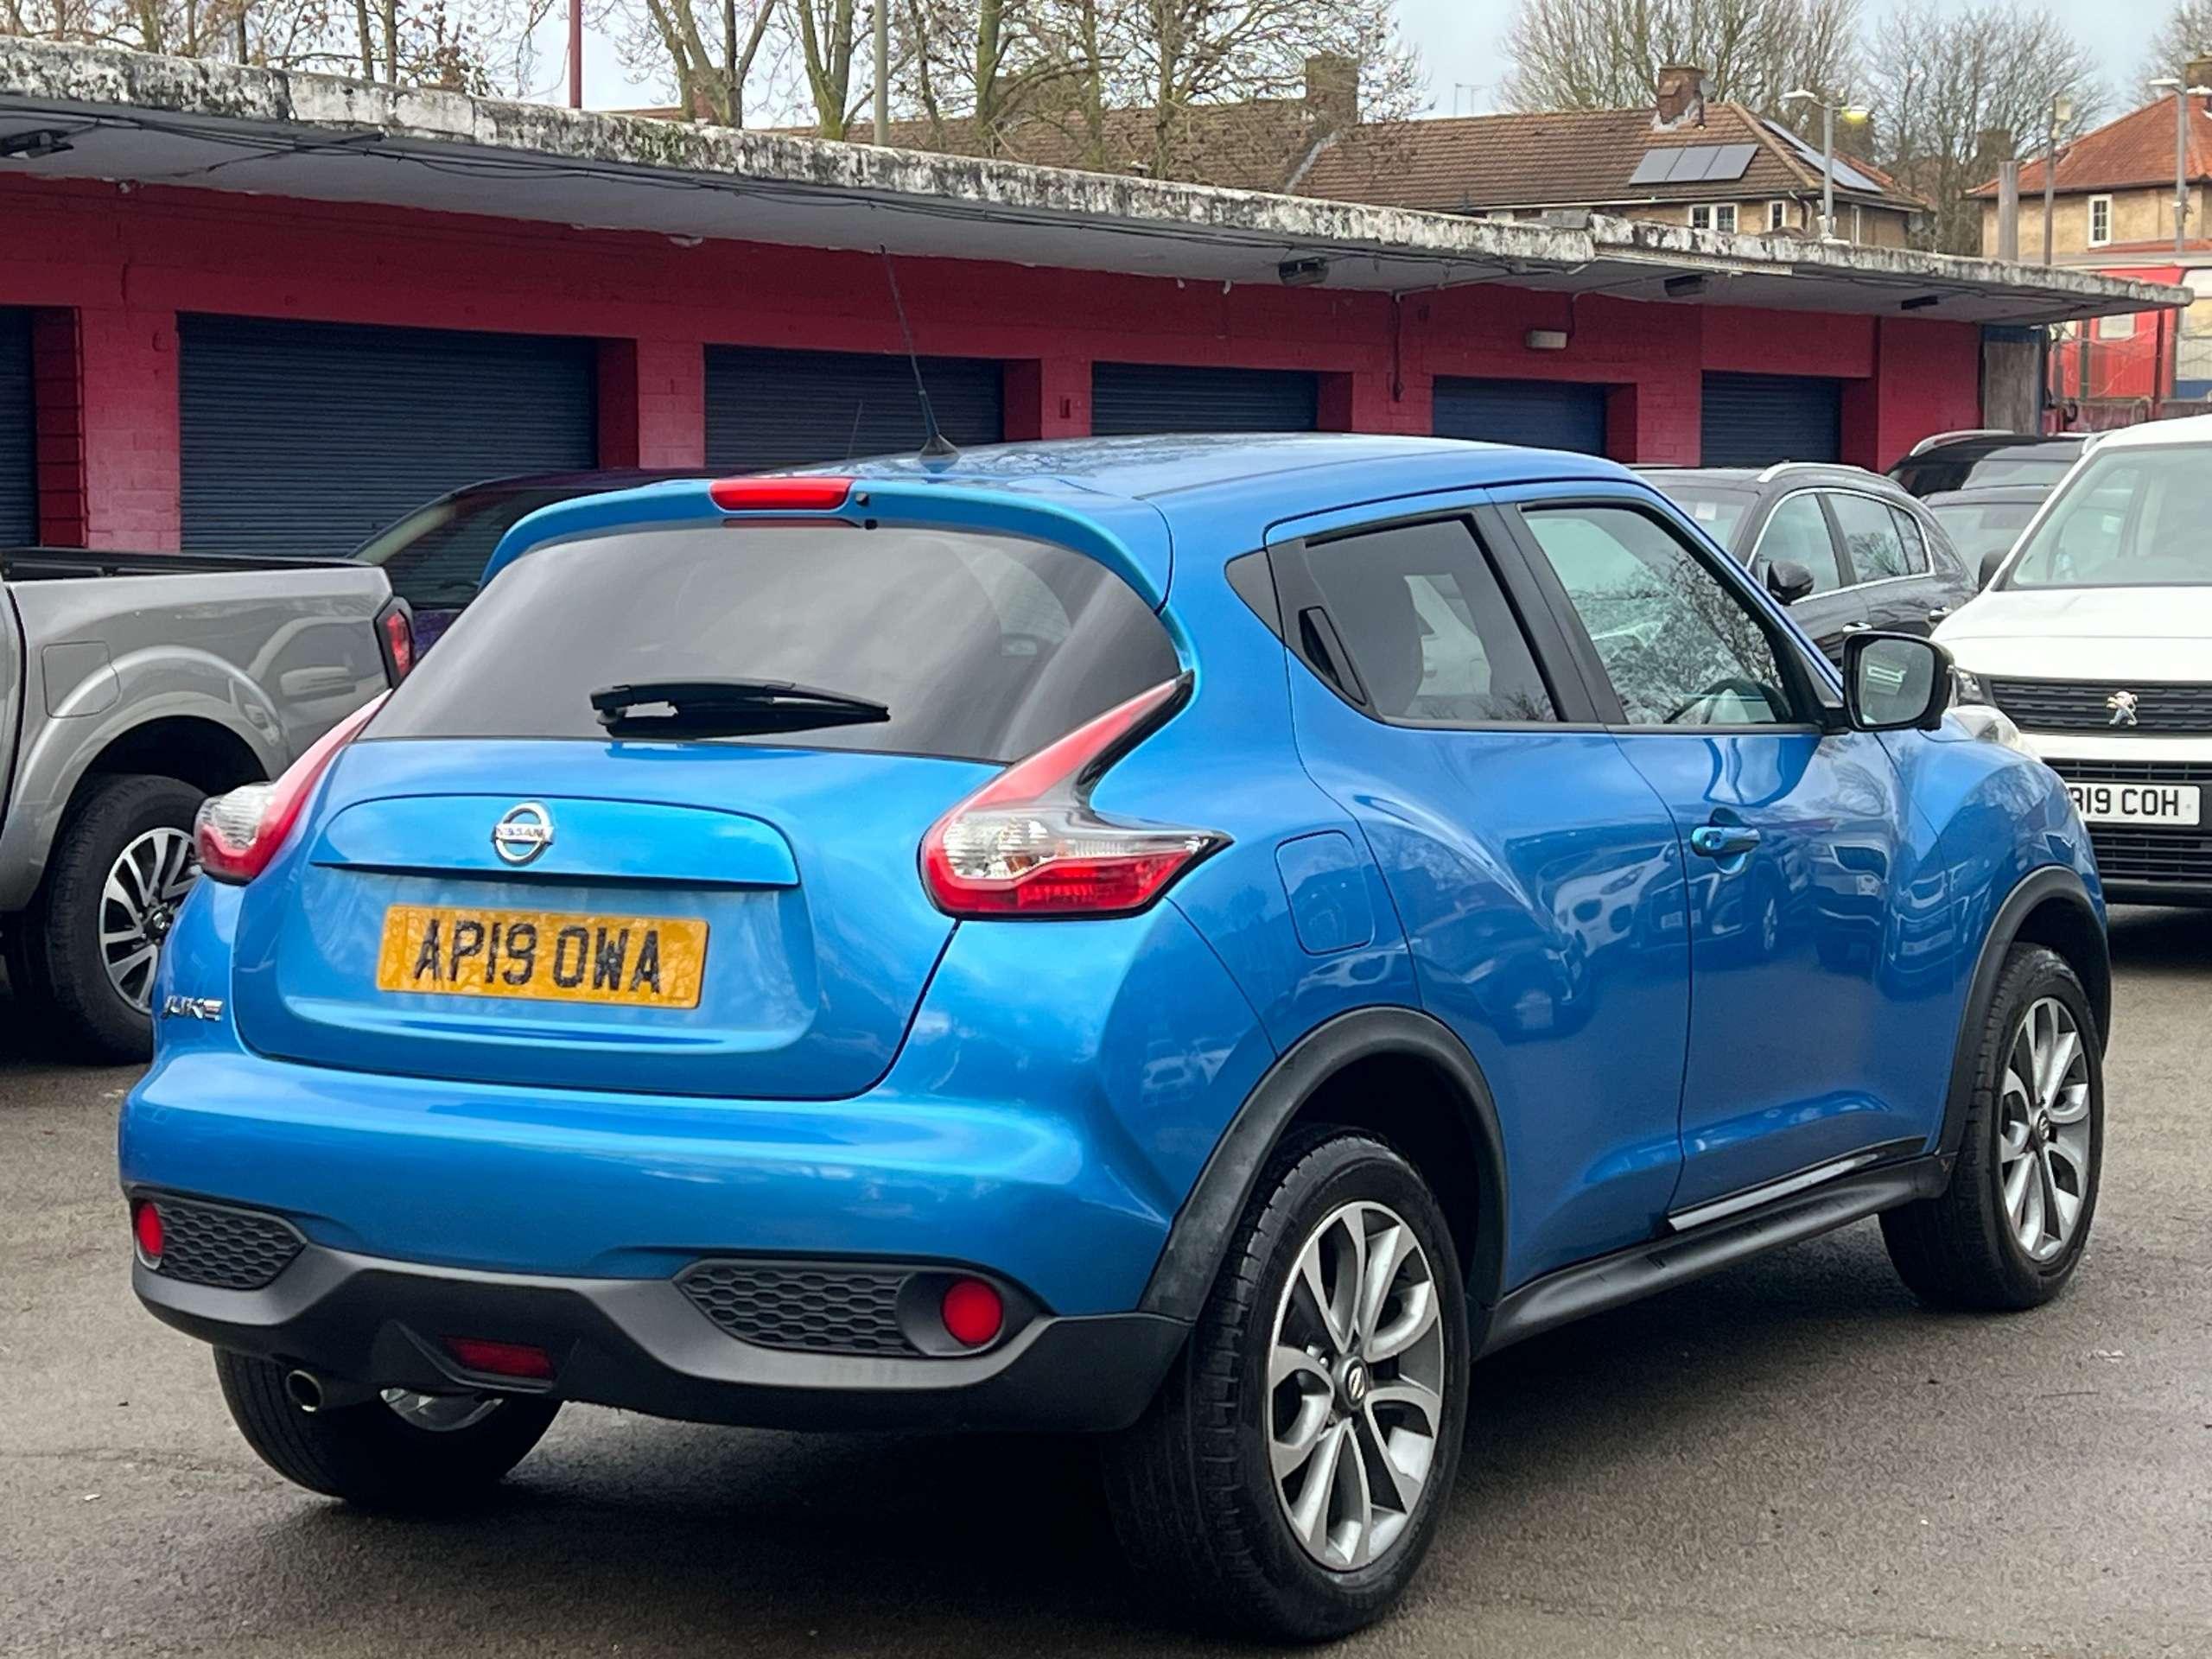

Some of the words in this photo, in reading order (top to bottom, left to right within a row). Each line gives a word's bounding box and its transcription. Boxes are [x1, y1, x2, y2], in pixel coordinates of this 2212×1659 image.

[2122, 789, 2178, 816] COH
[414, 919, 537, 985] AP19
[553, 925, 660, 994] OWA
